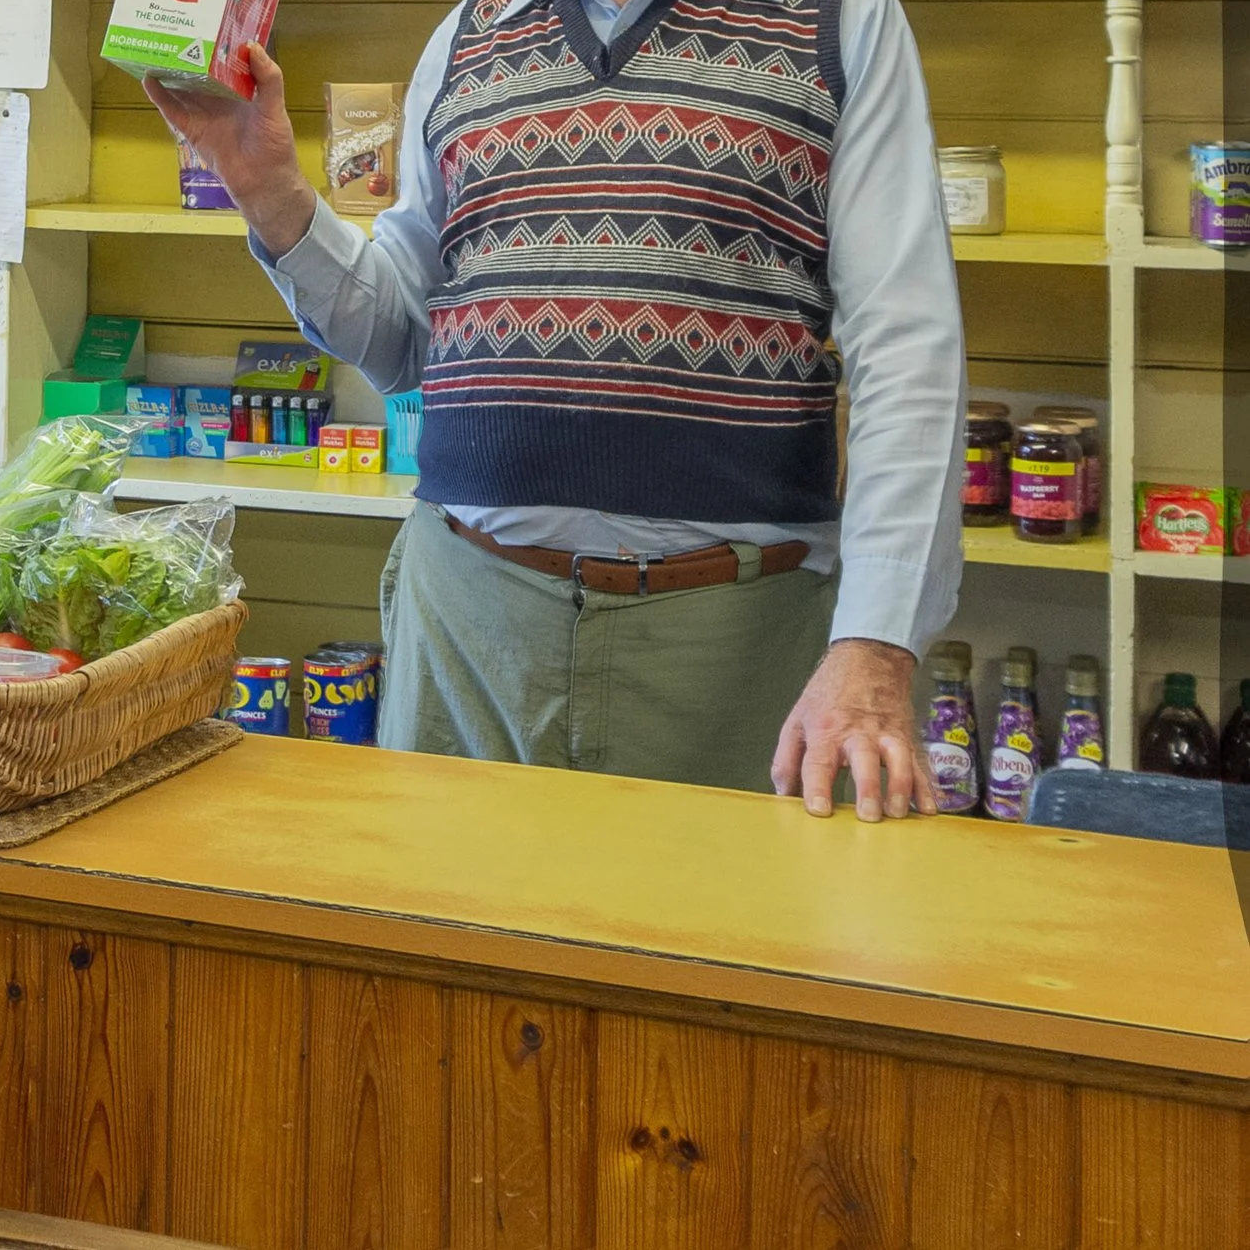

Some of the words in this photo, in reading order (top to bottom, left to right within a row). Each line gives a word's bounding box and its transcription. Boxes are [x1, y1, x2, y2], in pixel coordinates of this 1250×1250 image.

[135, 10, 151, 20] THE
[153, 13, 195, 28] ORIGINAL
[110, 34, 179, 54] BIODEGRADABLE
[345, 110, 379, 119] LINDOR
[257, 353, 297, 373] exis
